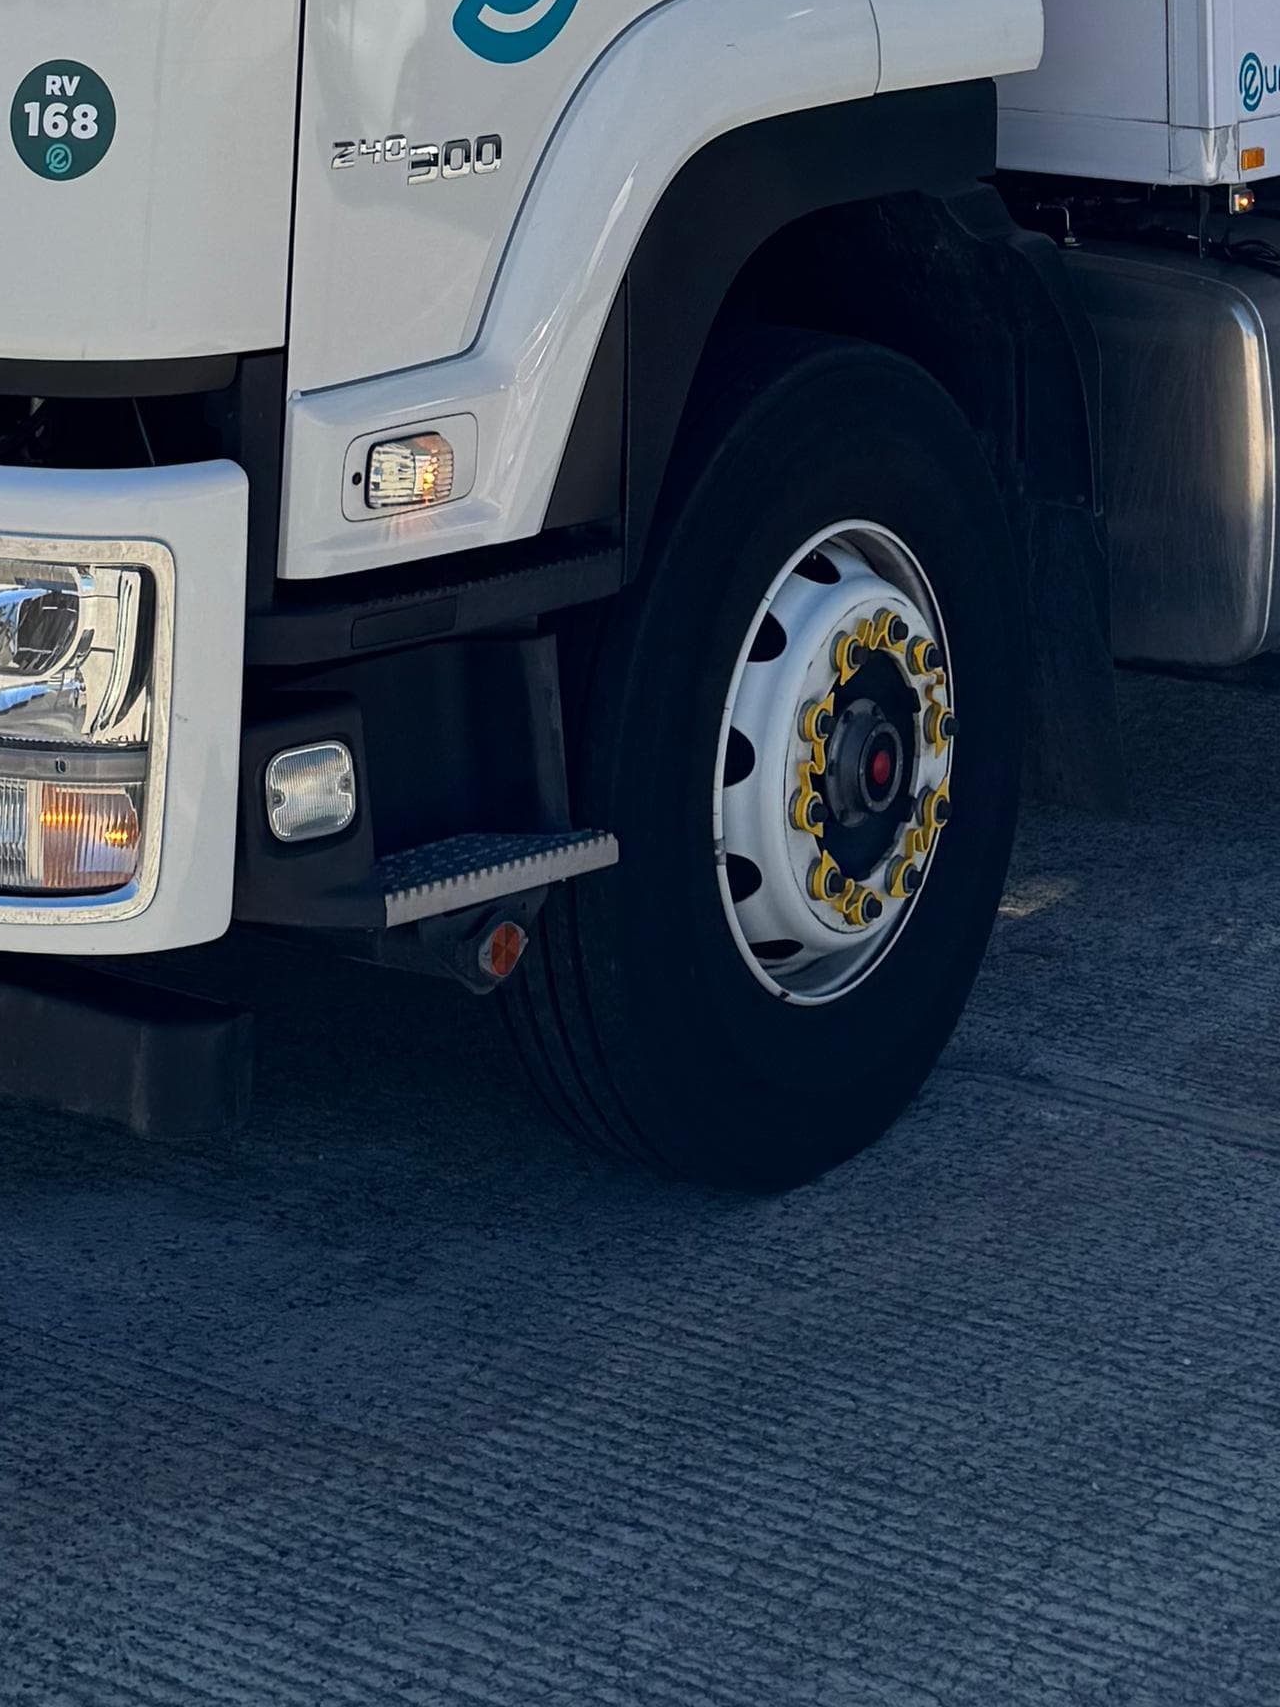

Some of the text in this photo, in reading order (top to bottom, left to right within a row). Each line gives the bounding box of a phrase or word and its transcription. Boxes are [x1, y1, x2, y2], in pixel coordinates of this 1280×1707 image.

[45, 74, 80, 96] RV
[23, 101, 99, 140] 168
[407, 134, 502, 185] 300
